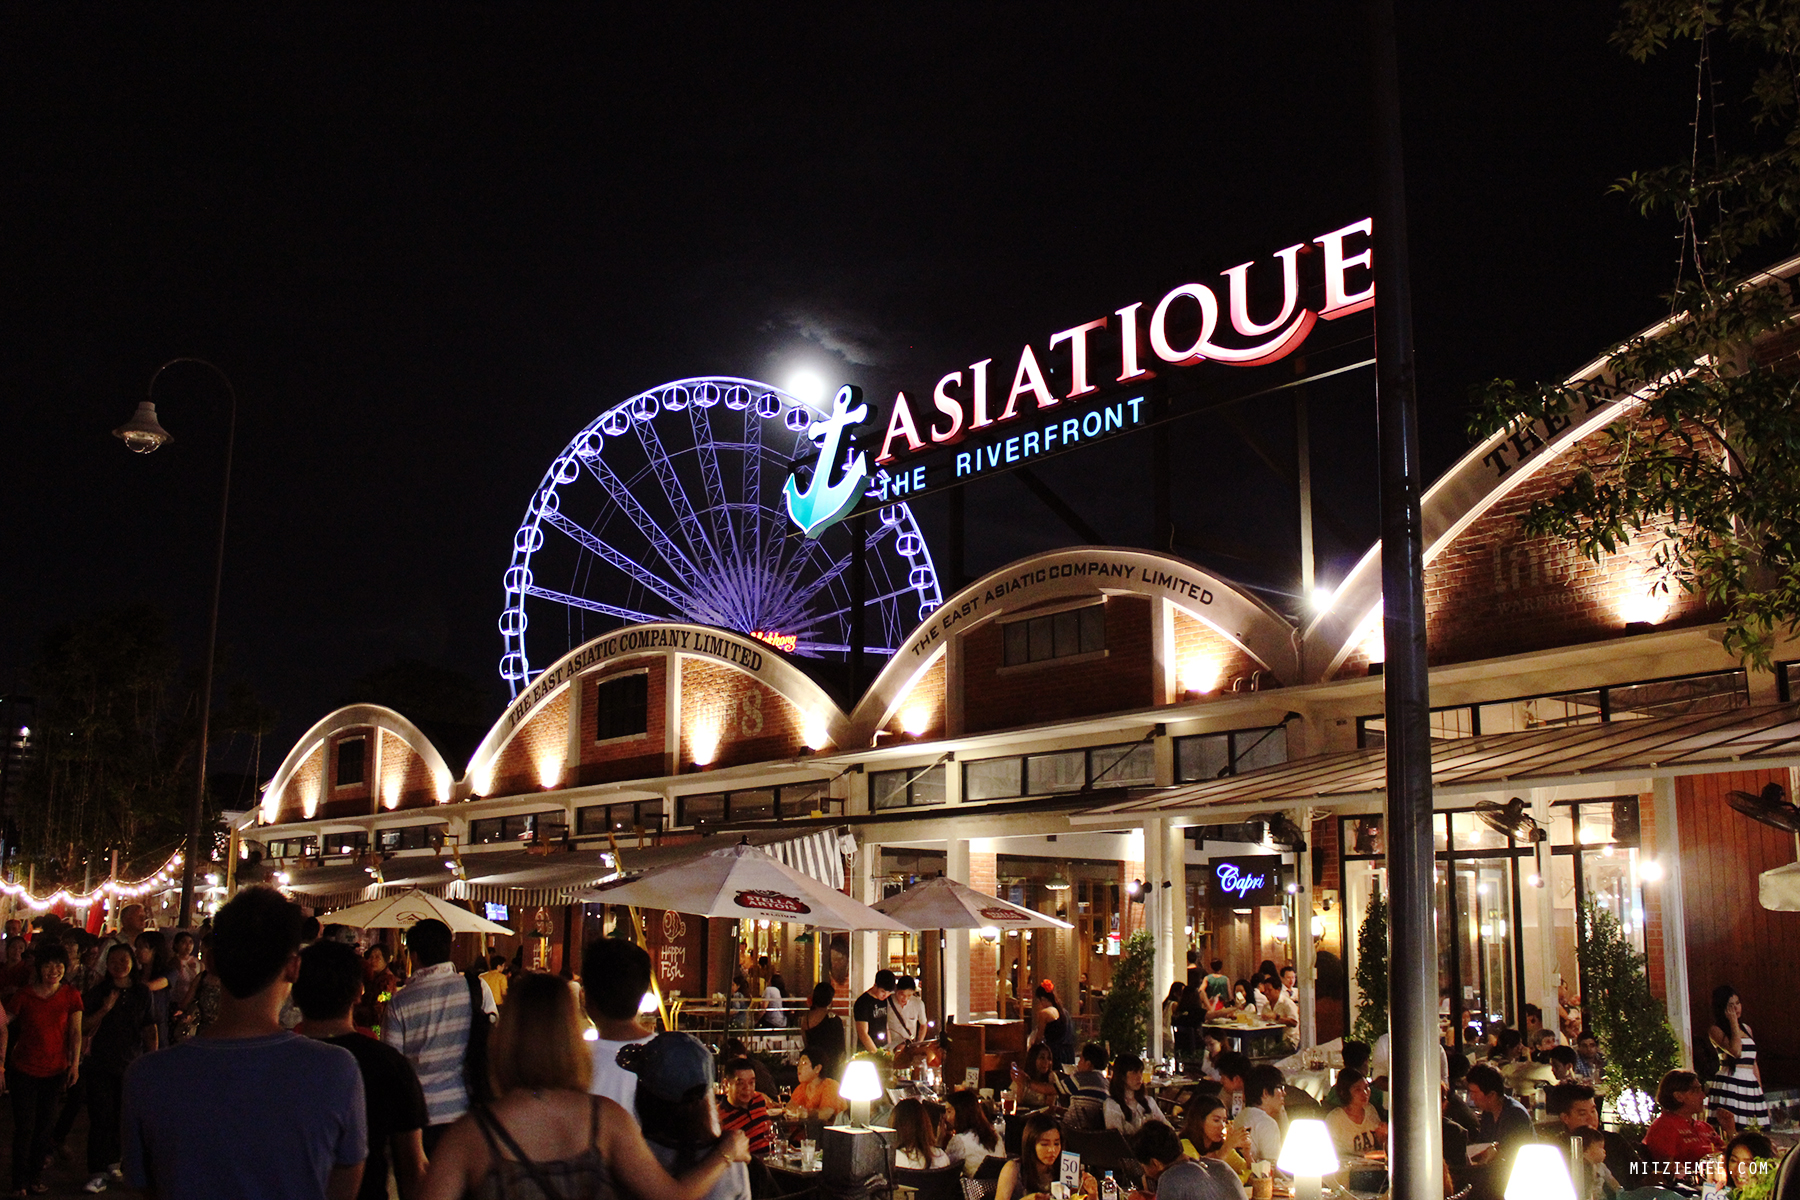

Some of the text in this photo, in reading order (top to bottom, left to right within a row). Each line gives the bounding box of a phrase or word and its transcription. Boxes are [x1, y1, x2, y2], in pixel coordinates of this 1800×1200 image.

[874, 216, 1375, 462] ASIATIQUE
[879, 396, 1145, 500] THE RIVERFRONT
[1483, 409, 1572, 477] THE
[912, 562, 1214, 656] THE EAST ASIATIC COMPANY LIMITED
[508, 629, 763, 728] THE EAST ASIATIC COMPANY LIMITED
[742, 689, 764, 737] 8
[747, 895, 794, 905] STELLA
[1216, 863, 1265, 898] Capri
[749, 900, 798, 911] ARTOIS
[661, 960, 685, 982] Fish
[1061, 1159, 1078, 1174] 50
